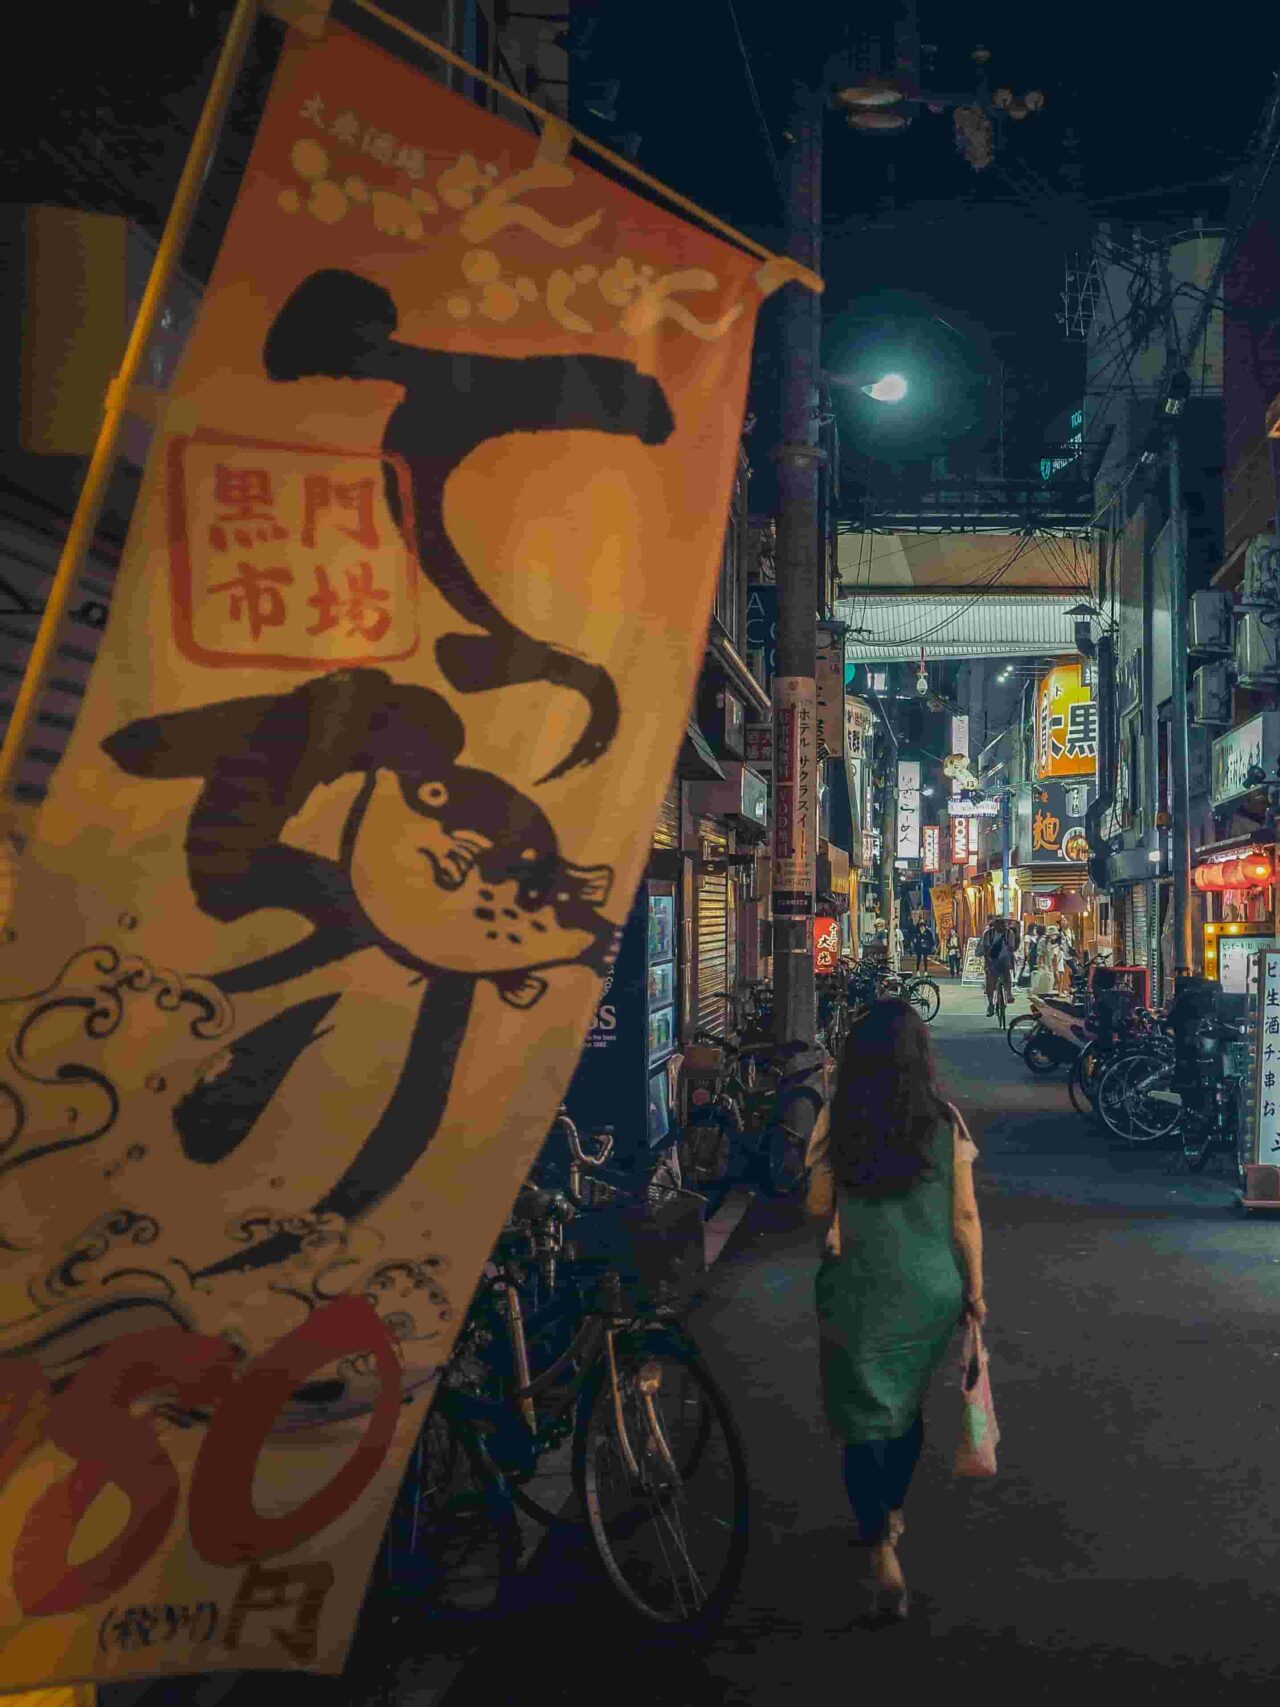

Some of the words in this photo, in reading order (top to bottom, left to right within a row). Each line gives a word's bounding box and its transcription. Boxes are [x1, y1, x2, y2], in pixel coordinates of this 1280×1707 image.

[207, 464, 383, 552] 黒門
[207, 562, 395, 642] 市場
[799, 708, 811, 747] ホテル
[798, 757, 810, 860] サクラスイート
[1264, 1016, 1280, 1034] 酒
[222, 1560, 335, 1661] 円
